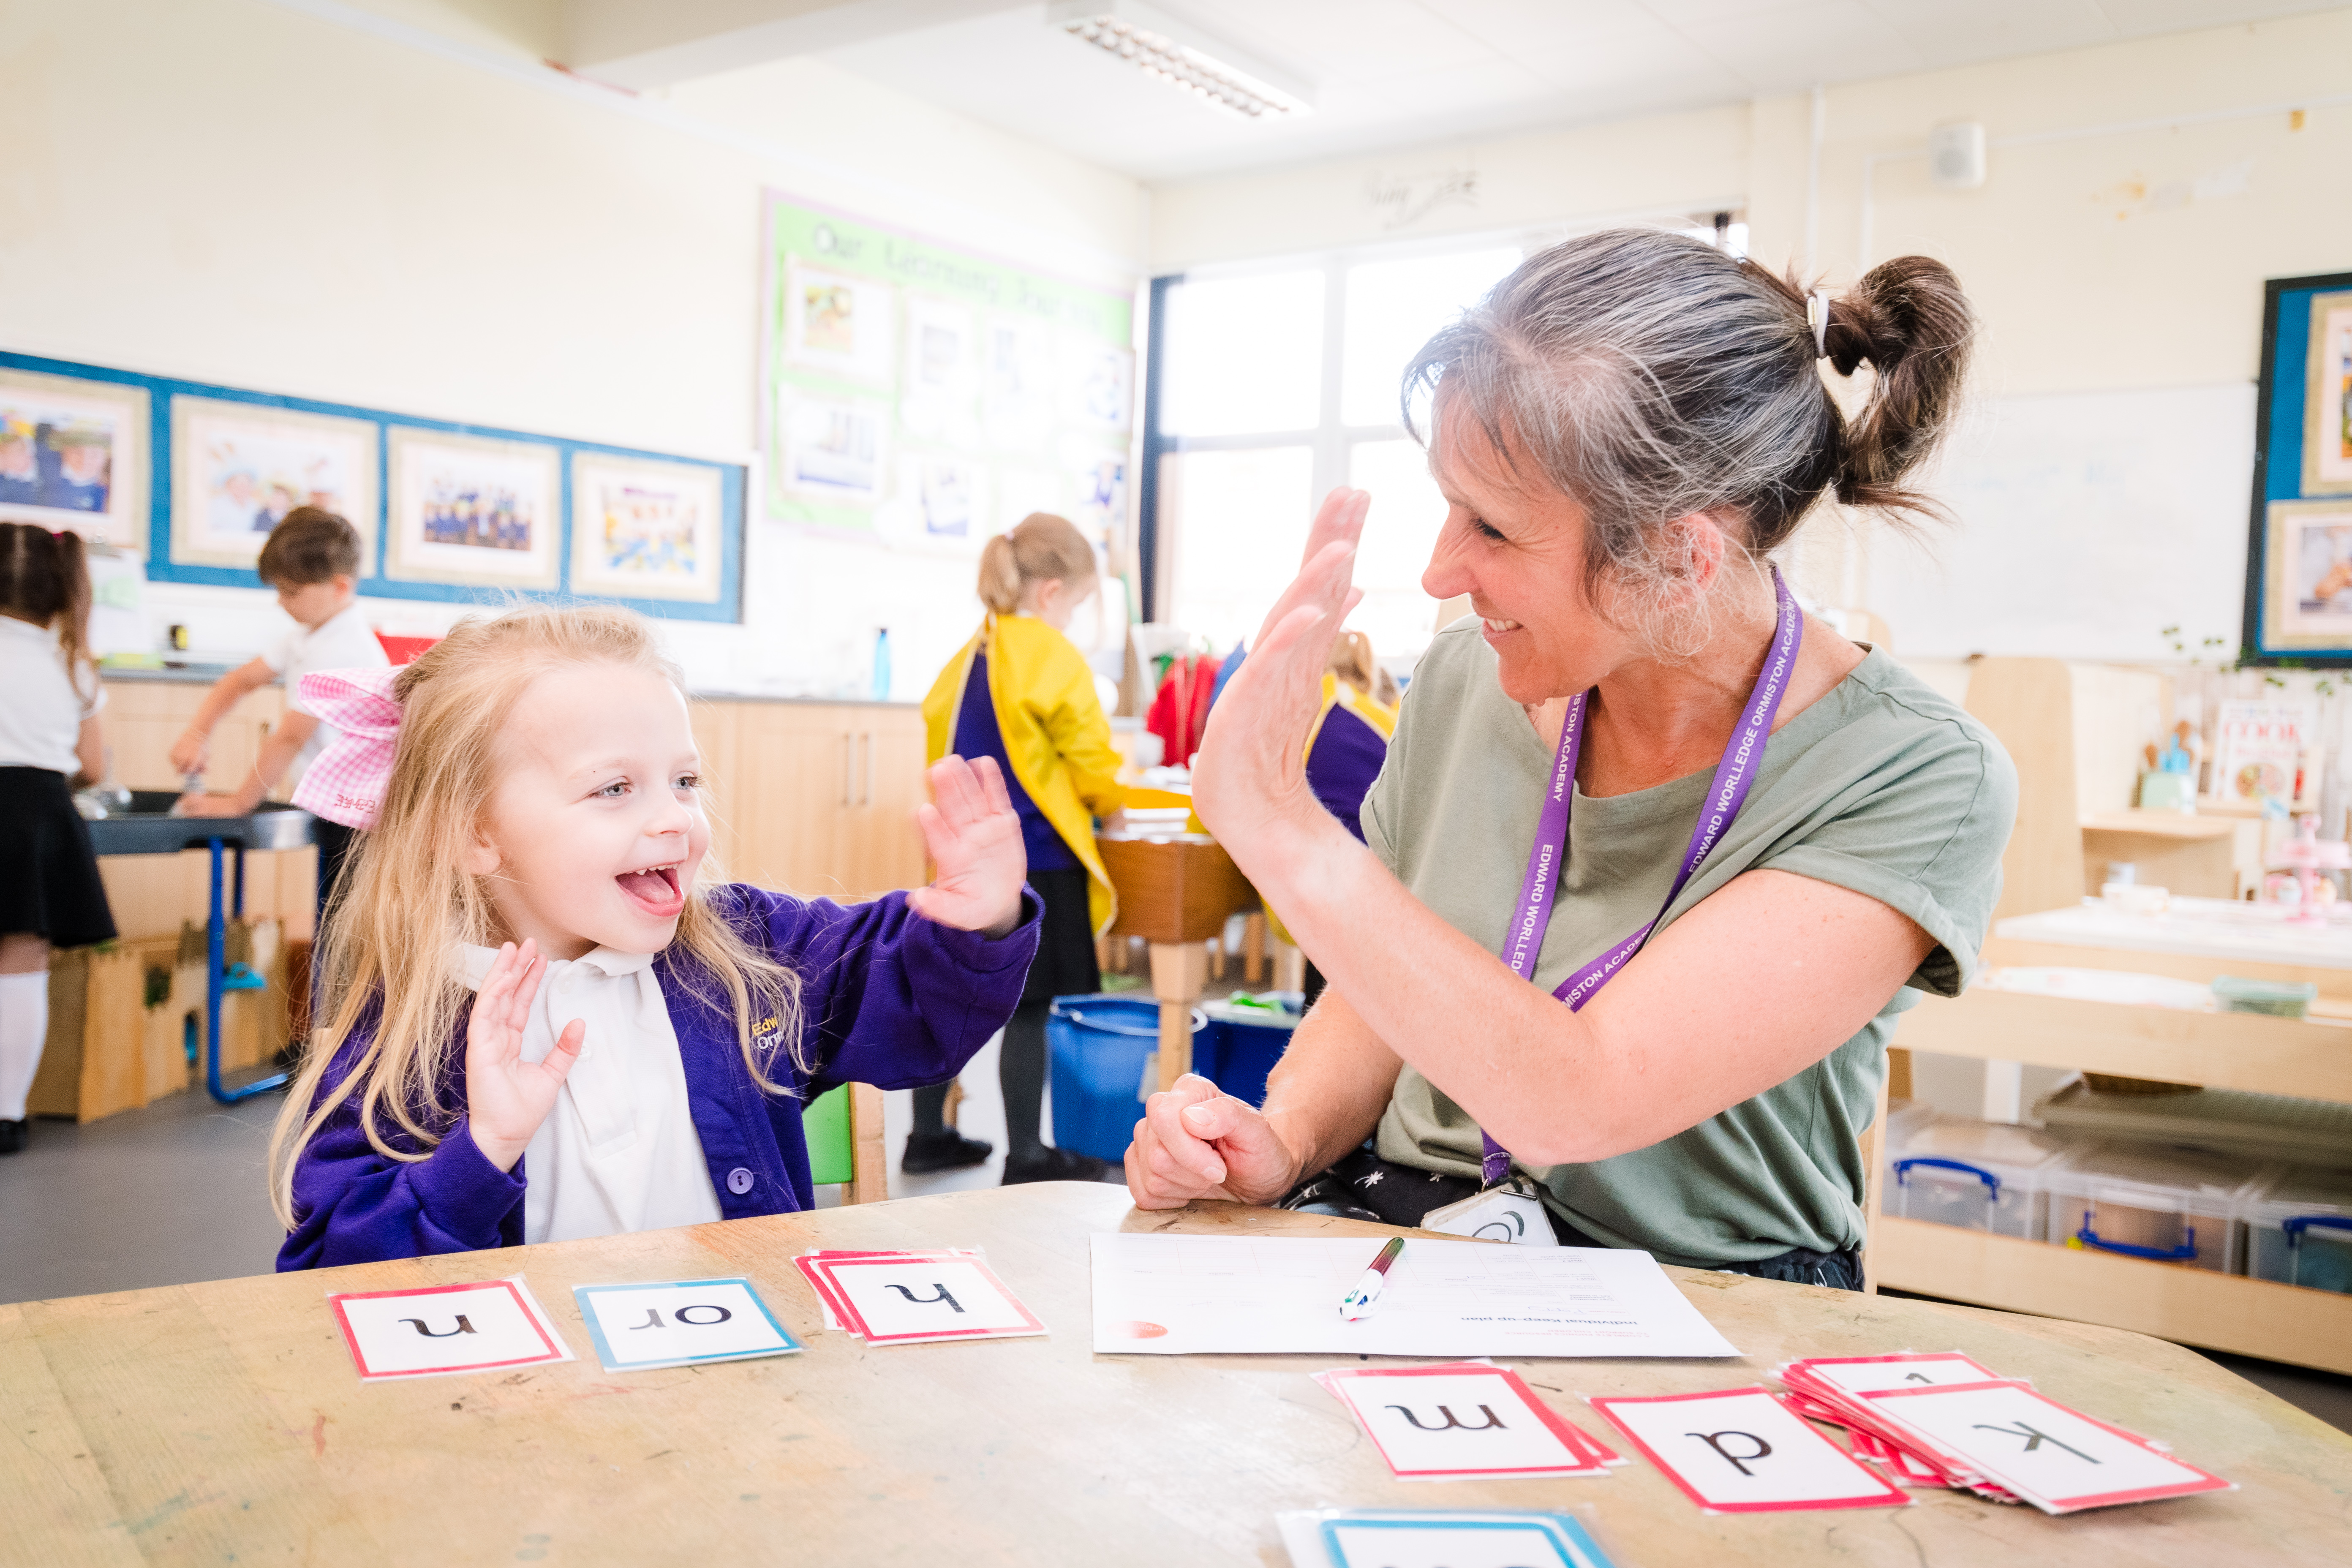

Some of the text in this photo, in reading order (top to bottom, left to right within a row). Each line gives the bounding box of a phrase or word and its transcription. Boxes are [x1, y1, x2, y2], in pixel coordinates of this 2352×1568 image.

[1553, 693, 1582, 802] ISTON ACADEMY
[1689, 593, 1795, 873] EDWARD WORLLEDGE ORMISTON ACADEMY
[1531, 844, 1553, 902] EDWARD
[1605, 925, 1652, 973] ACADEM
[752, 1016, 779, 1036] Edw
[629, 1305, 732, 1330] or
[885, 1283, 966, 1312] h
[1385, 1404, 1510, 1432] m
[1971, 1421, 2103, 1466] k
